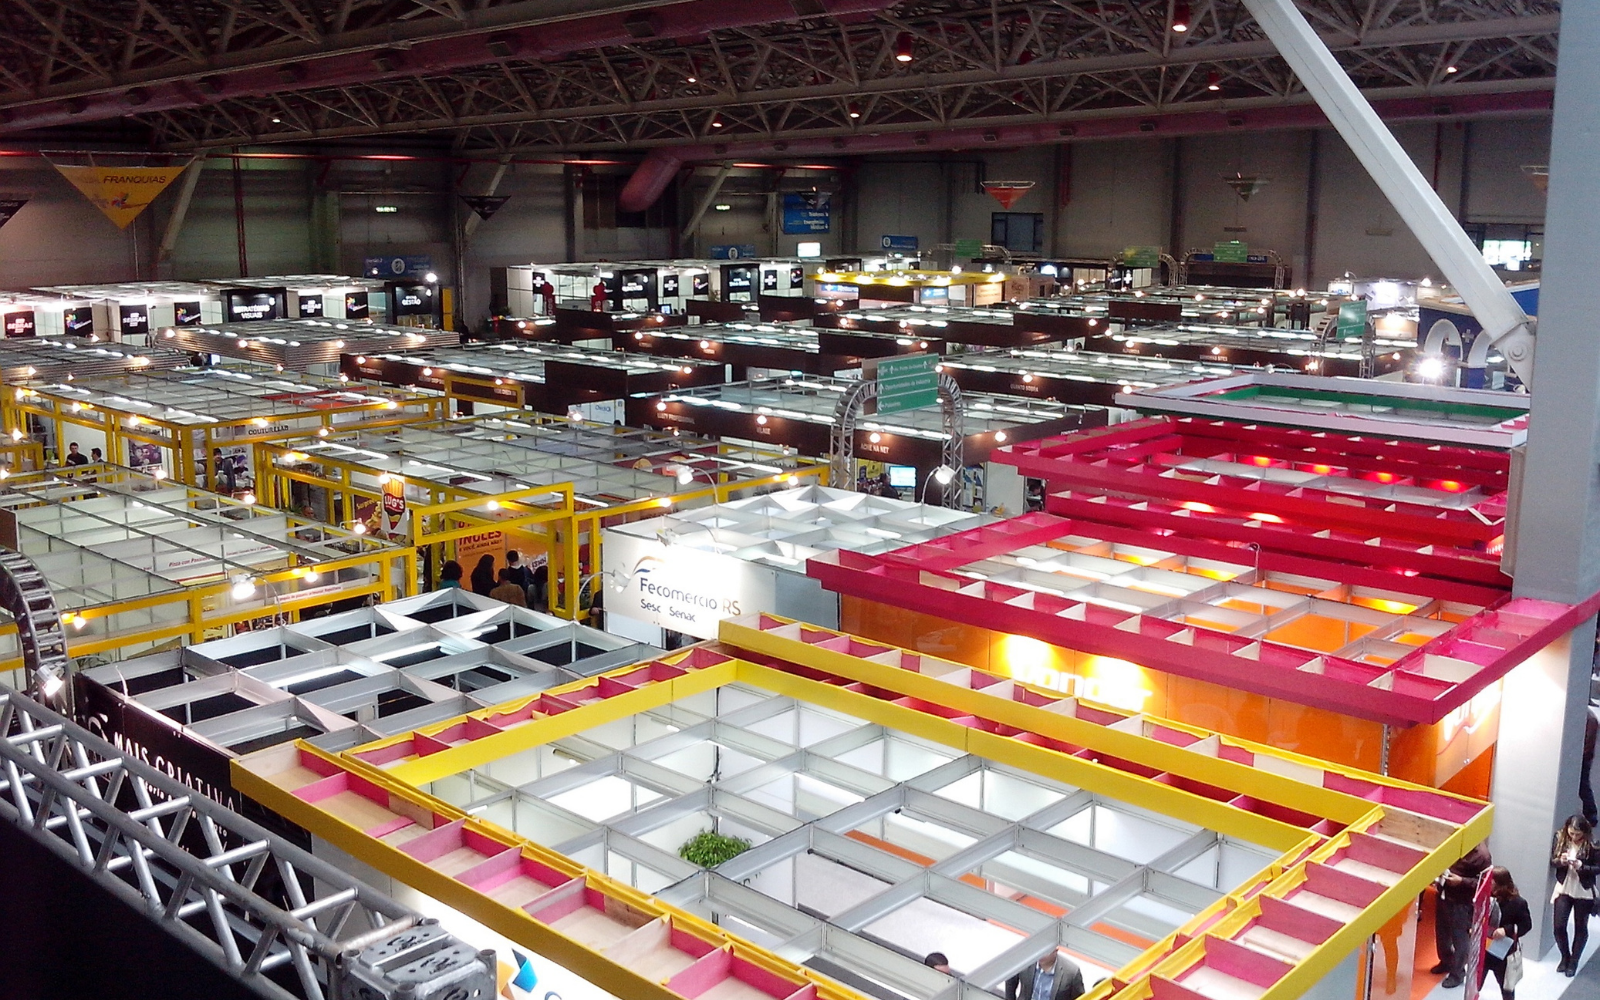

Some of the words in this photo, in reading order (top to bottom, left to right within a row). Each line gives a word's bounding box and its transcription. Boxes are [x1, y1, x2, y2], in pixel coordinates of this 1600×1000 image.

[103, 175, 167, 184] FRANQUIAS
[384, 495, 405, 510] LUG'S
[640, 598, 662, 613] Sesc
[669, 606, 696, 622] Senac
[722, 598, 741, 616] RS
